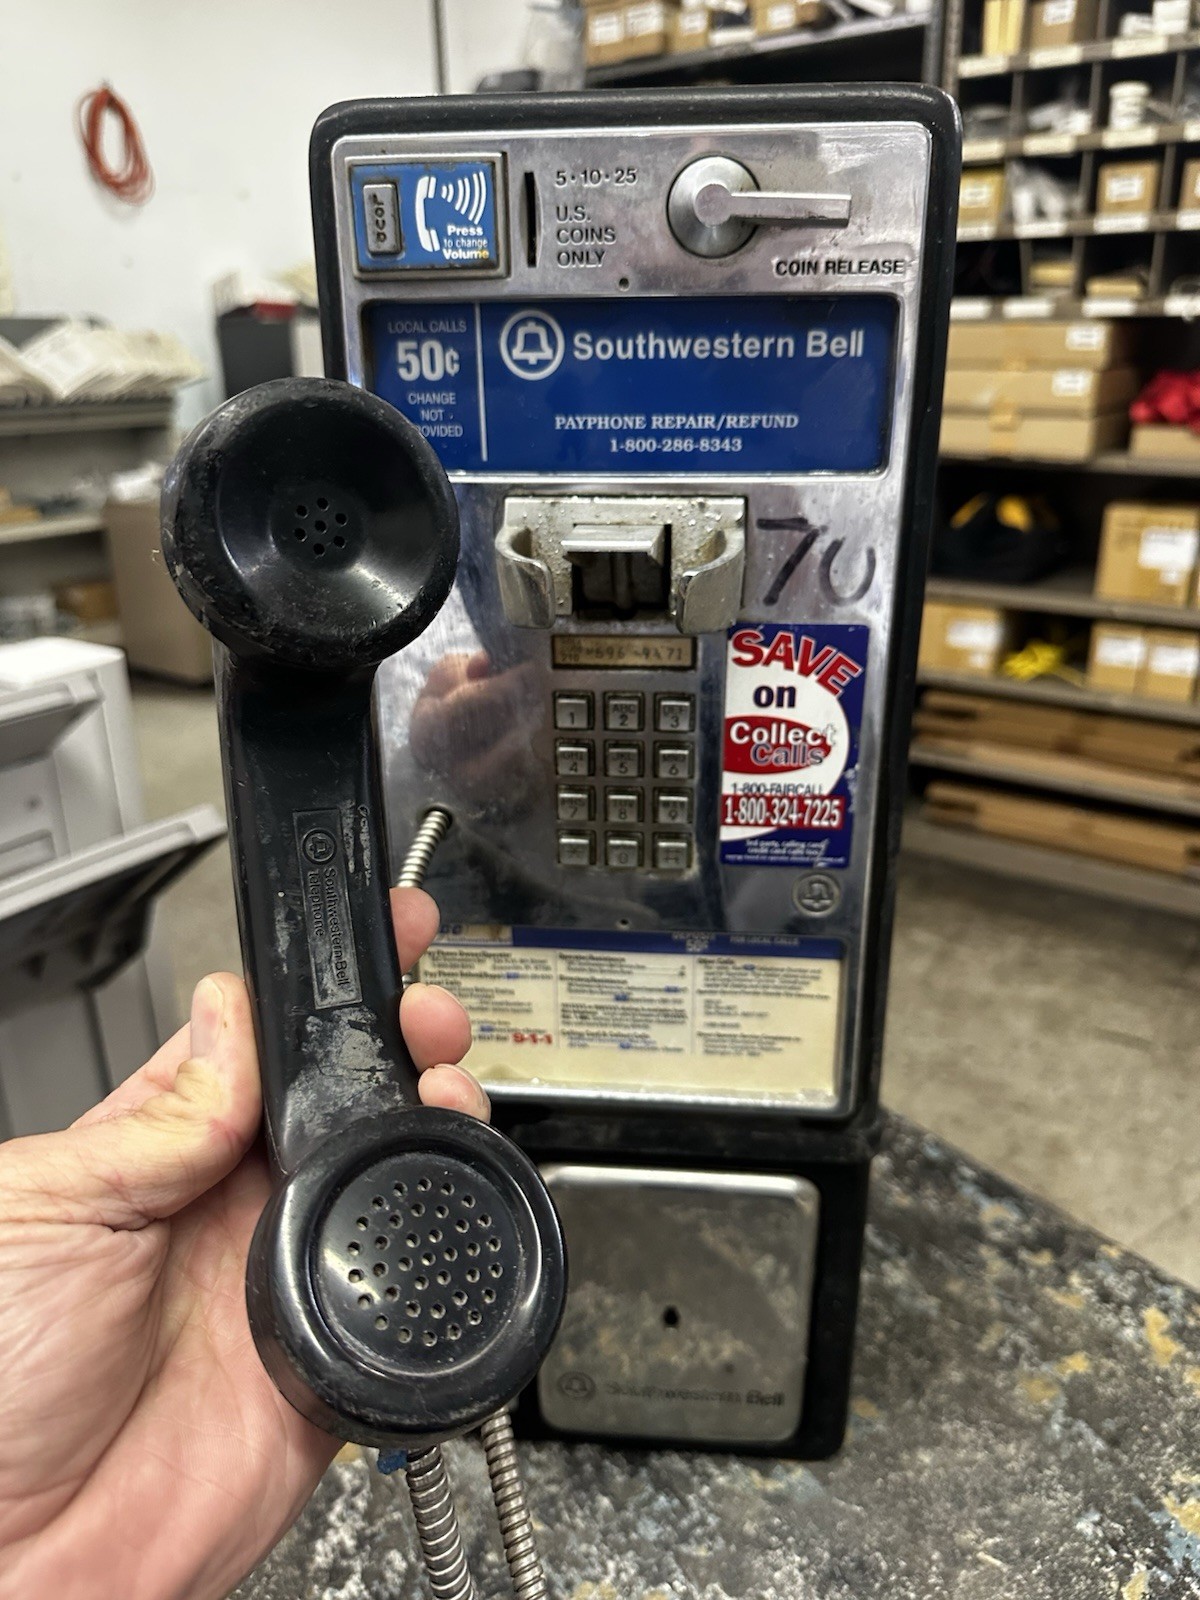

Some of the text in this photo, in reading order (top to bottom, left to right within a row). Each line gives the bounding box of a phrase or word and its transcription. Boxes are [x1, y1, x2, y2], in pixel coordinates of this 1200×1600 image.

[556, 205, 591, 223] U.S.
[447, 225, 483, 236] Press
[556, 227, 616, 245] COINS
[443, 239, 488, 250] to change
[442, 249, 489, 260] Volume
[556, 249, 606, 268] ONLY
[774, 259, 906, 276] COIN RELEASE
[388, 320, 467, 334] LOCAL CALLS
[572, 329, 864, 361] Southwestern Bell
[397, 340, 460, 381] 50¢
[408, 392, 457, 405] CHANGE
[421, 409, 444, 421] NOT
[554, 414, 800, 431] PAYPHONE REPAIR/REFUND
[418, 425, 463, 437] OVIDED
[609, 438, 743, 452] 1-800-286-8343
[731, 629, 863, 698] SAVE
[753, 684, 797, 708] on
[569, 711, 576, 726] 1
[619, 713, 629, 726] 2
[670, 715, 680, 728] 3
[730, 721, 836, 746] Collect
[751, 743, 824, 766] Calls
[568, 762, 579, 774] 4
[618, 762, 629, 774] 5
[668, 764, 679, 776] 6
[568, 806, 578, 819] 7
[618, 808, 628, 820] 8
[668, 809, 679, 821] 9
[724, 797, 841, 827] 1-800-324-7225
[308, 871, 326, 937] Telephone
[324, 868, 350, 987] Southwestern Bell
